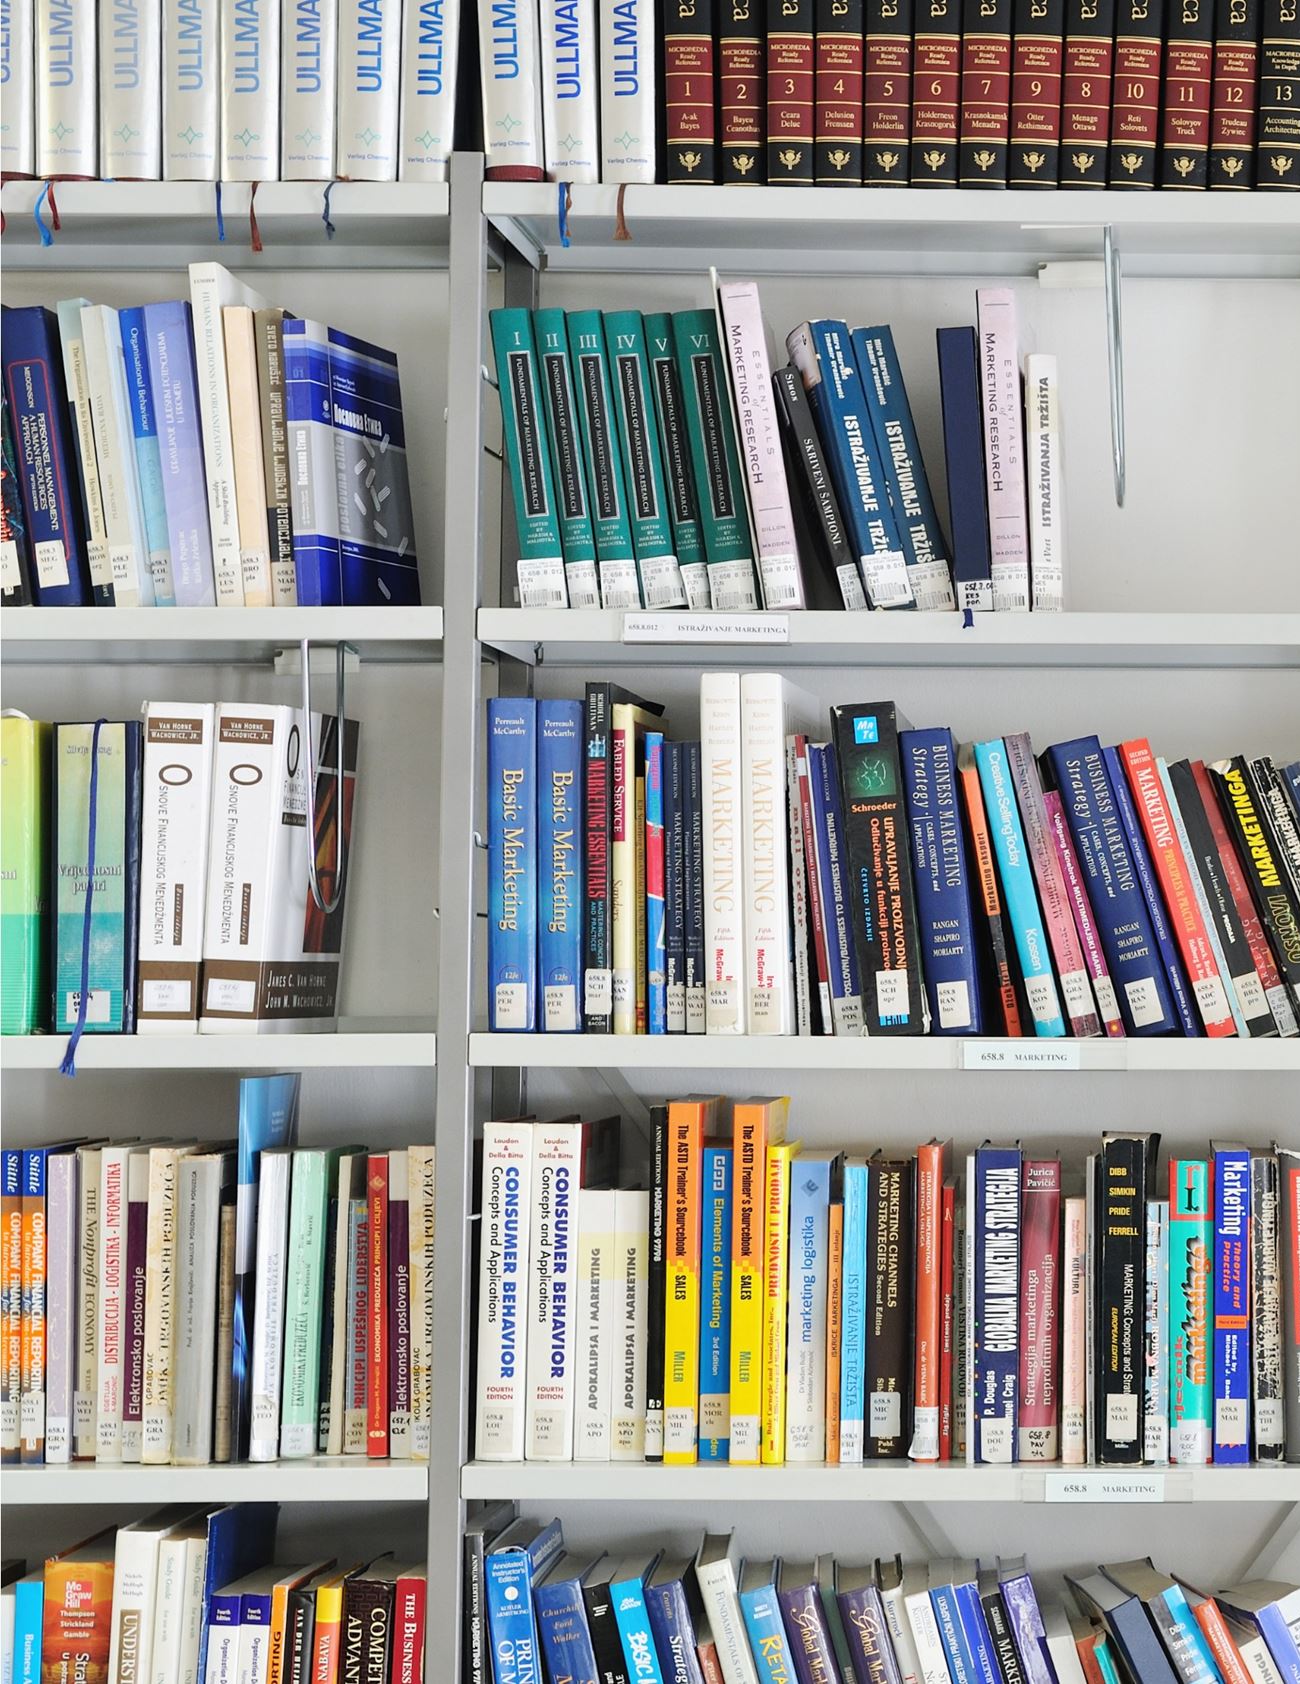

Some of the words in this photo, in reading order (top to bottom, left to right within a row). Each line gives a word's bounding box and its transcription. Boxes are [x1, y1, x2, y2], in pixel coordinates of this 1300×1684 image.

[685, 82, 691, 97] 1
[1081, 82, 1091, 97] 8
[1128, 83, 1144, 99] 10
[1225, 86, 1243, 102] 12
[1221, 119, 1246, 127] Trudeau
[1222, 127, 1245, 136] Zywiec
[579, 335, 597, 348] III
[617, 334, 636, 348] IV
[655, 338, 667, 352] V
[130, 327, 145, 388] Organisational
[138, 388, 148, 432] Behaviour
[516, 359, 529, 415] FUNDAMENTALS
[985, 333, 998, 413] MARKETING
[523, 415, 529, 426] OF
[1038, 377, 1049, 429] TRŽIŠTA
[523, 428, 534, 469] MARKETING
[843, 416, 879, 512] ISTRAŽIVANJE
[989, 417, 1003, 491] RESEARCH
[529, 470, 540, 509] RESEARCH
[803, 438, 825, 490] SKRIVENI
[818, 491, 842, 545] ŠAMPIONI
[1039, 433, 1051, 527] ISTRAŽIVANJA
[628, 623, 658, 632] 658.8.012
[677, 623, 732, 634] ISTRAŽIVANJE
[733, 624, 787, 635] MARKETINGA
[151, 731, 187, 739] WACHOWICZ,
[159, 722, 170, 730] VAN
[172, 723, 192, 731] HORNE
[494, 727, 526, 736] McCarthy
[495, 717, 524, 727] Perreault
[501, 768, 524, 822] Basic
[932, 745, 952, 806] BUSINESS
[988, 752, 1009, 798] Creative
[851, 802, 896, 814] Schroeder
[997, 797, 1013, 834] Selling
[1136, 768, 1173, 848] MARKETING
[1224, 769, 1281, 888] MARKETINGA
[711, 759, 733, 913] MARKETING
[939, 810, 961, 887] MARKETING
[1005, 834, 1020, 867] Today
[500, 827, 524, 931] Marketing
[933, 920, 959, 929] RANGAN
[934, 934, 960, 942] SHAPIRO
[933, 946, 964, 957] MORIARTY
[1025, 928, 1041, 971] Kossen
[981, 1053, 1004, 1061] 658.8
[1015, 1054, 1067, 1062] MARKETING
[1027, 1178, 1055, 1187] Pavičić
[1028, 1169, 1054, 1177] Jurica
[1109, 1168, 1126, 1176] DIBB
[1109, 1188, 1135, 1196] SIMKIN
[488, 1167, 503, 1221] Concepts
[985, 1168, 1018, 1225] STRATEGIJA
[1109, 1207, 1130, 1215] PRIDE
[1219, 1161, 1247, 1235] Marketing
[490, 1222, 502, 1247] and
[503, 1167, 519, 1274] CONSUMER
[713, 1198, 725, 1252] Elements
[1109, 1227, 1138, 1236] FERRELL
[105, 1236, 120, 1287] LOGISTIKA
[714, 1256, 721, 1267] of
[801, 1216, 815, 1271] logistika
[985, 1227, 1018, 1294] MARKETING
[132, 1267, 146, 1336] poslovanje
[487, 1251, 501, 1323] Applications
[626, 1248, 636, 1320] MARKETING
[675, 1275, 686, 1300] SALES
[709, 1270, 724, 1328] Marketing
[500, 1281, 516, 1378] BEHAVIOR
[800, 1276, 815, 1343] marketing
[984, 1297, 1016, 1352] GLOBALNA
[104, 1297, 119, 1364] DISTRIBUCIJA
[129, 1340, 142, 1414] Elektronsko
[625, 1338, 636, 1409] APOKALIPSA
[1064, 1485, 1087, 1493] 658.8
[1102, 1485, 1155, 1493] MARKETING
[65, 1590, 91, 1600] Graw
[65, 1599, 80, 1608] Hill
[66, 1581, 81, 1590] Mc
[317, 1634, 330, 1681] NABAVA
